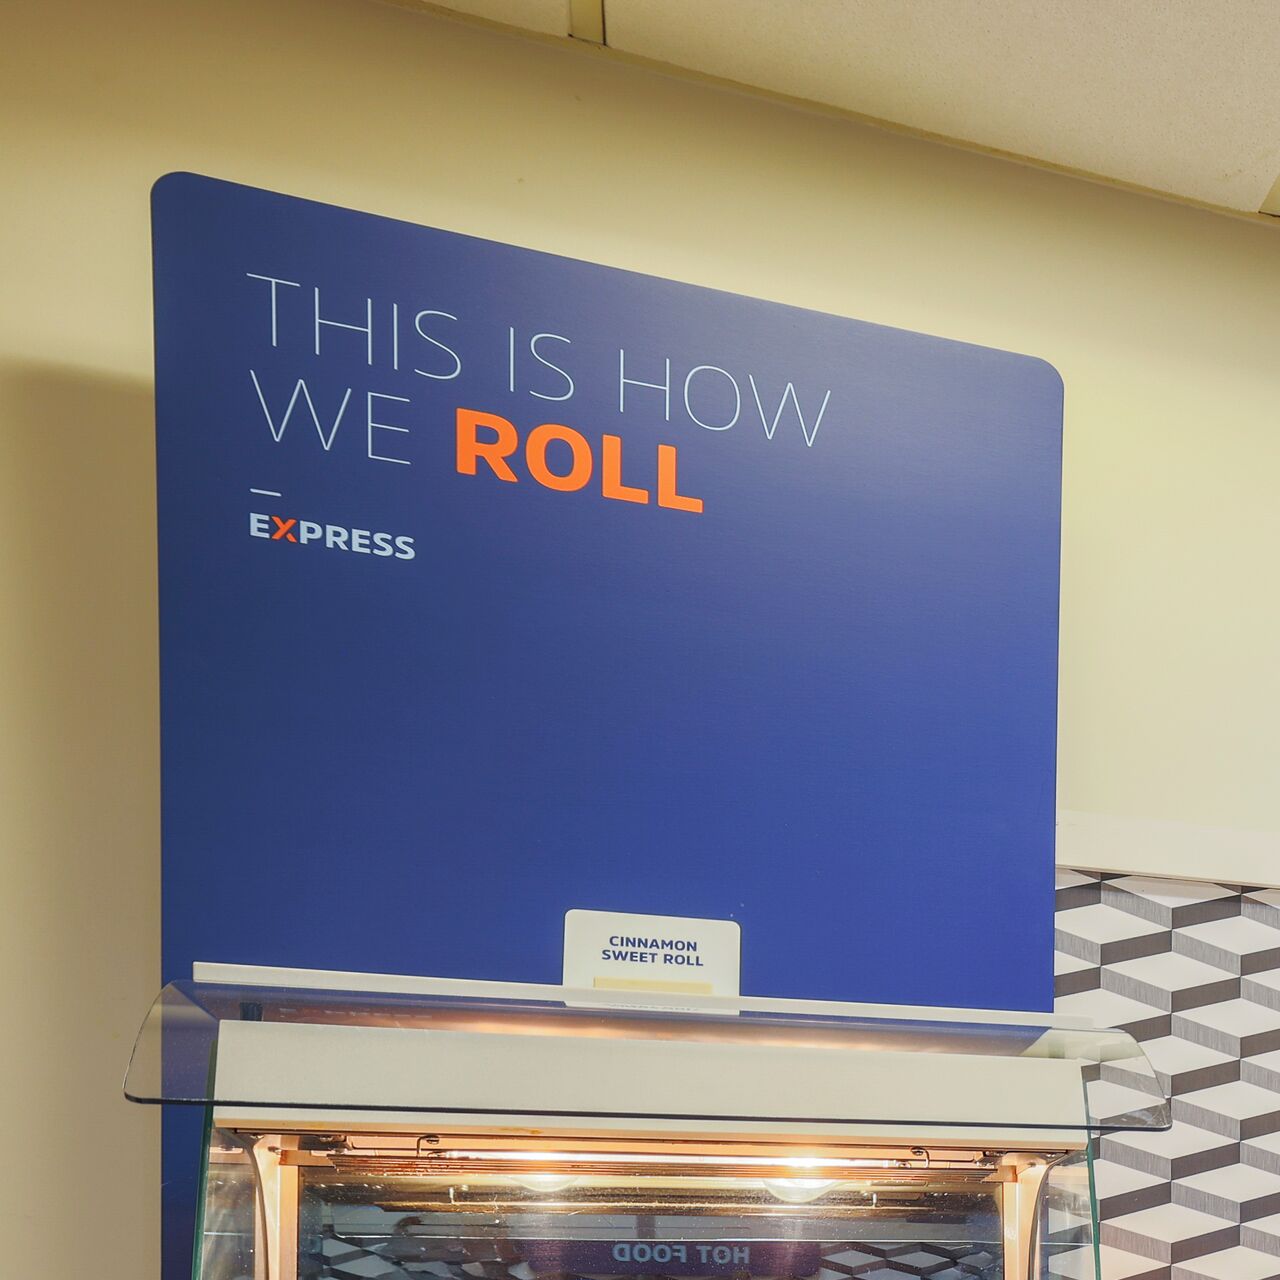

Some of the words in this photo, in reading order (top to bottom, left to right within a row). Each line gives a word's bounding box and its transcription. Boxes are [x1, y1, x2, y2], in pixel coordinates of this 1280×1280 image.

[247, 272, 461, 379] THIS
[509, 327, 575, 400] IS
[619, 349, 831, 447] HOW
[249, 369, 411, 465] WE
[456, 407, 704, 513] ROLL
[249, 512, 416, 560] EXPRESS
[602, 949, 658, 963] SWEET
[664, 953, 704, 966] ROLL
[609, 935, 697, 952] CINNAMON
